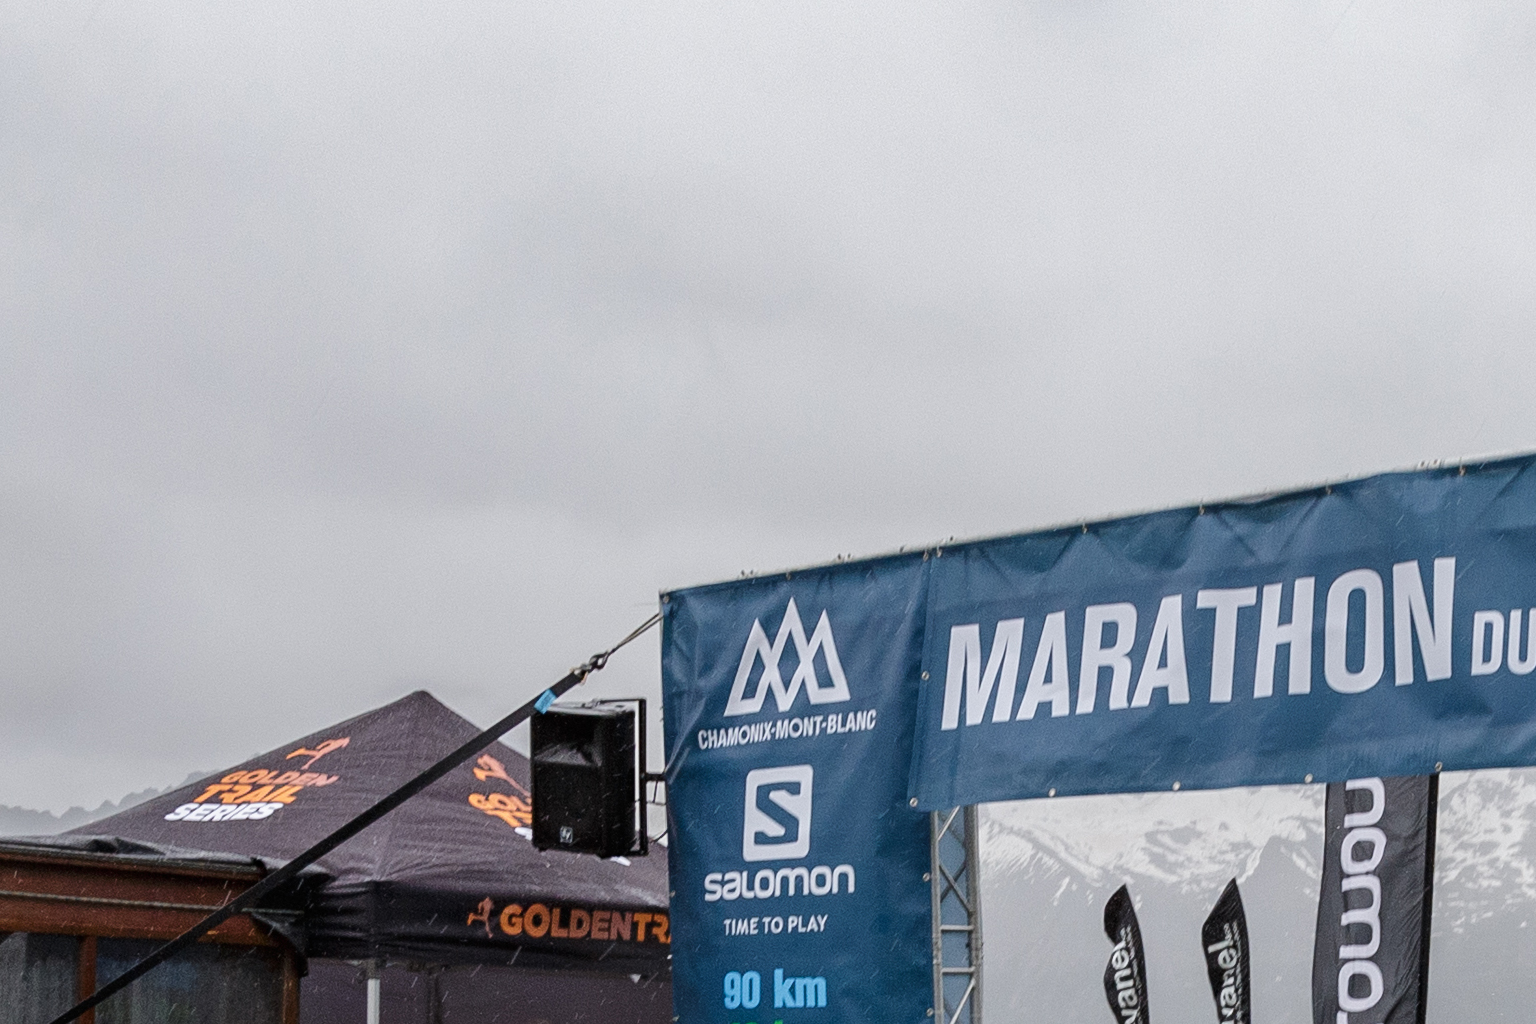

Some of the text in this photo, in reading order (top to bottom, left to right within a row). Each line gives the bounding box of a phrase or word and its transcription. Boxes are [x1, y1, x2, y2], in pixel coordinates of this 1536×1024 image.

[941, 557, 1456, 731] MARATHON
[698, 709, 877, 750] CHAMONIX-MONT-BLANC
[220, 769, 340, 787] GOLDEN
[193, 784, 304, 804] TRAIL
[164, 802, 284, 822] SERIES
[704, 864, 855, 901] salomon
[724, 914, 828, 936] TIME TO PLAY
[724, 968, 827, 1009] 90 km
